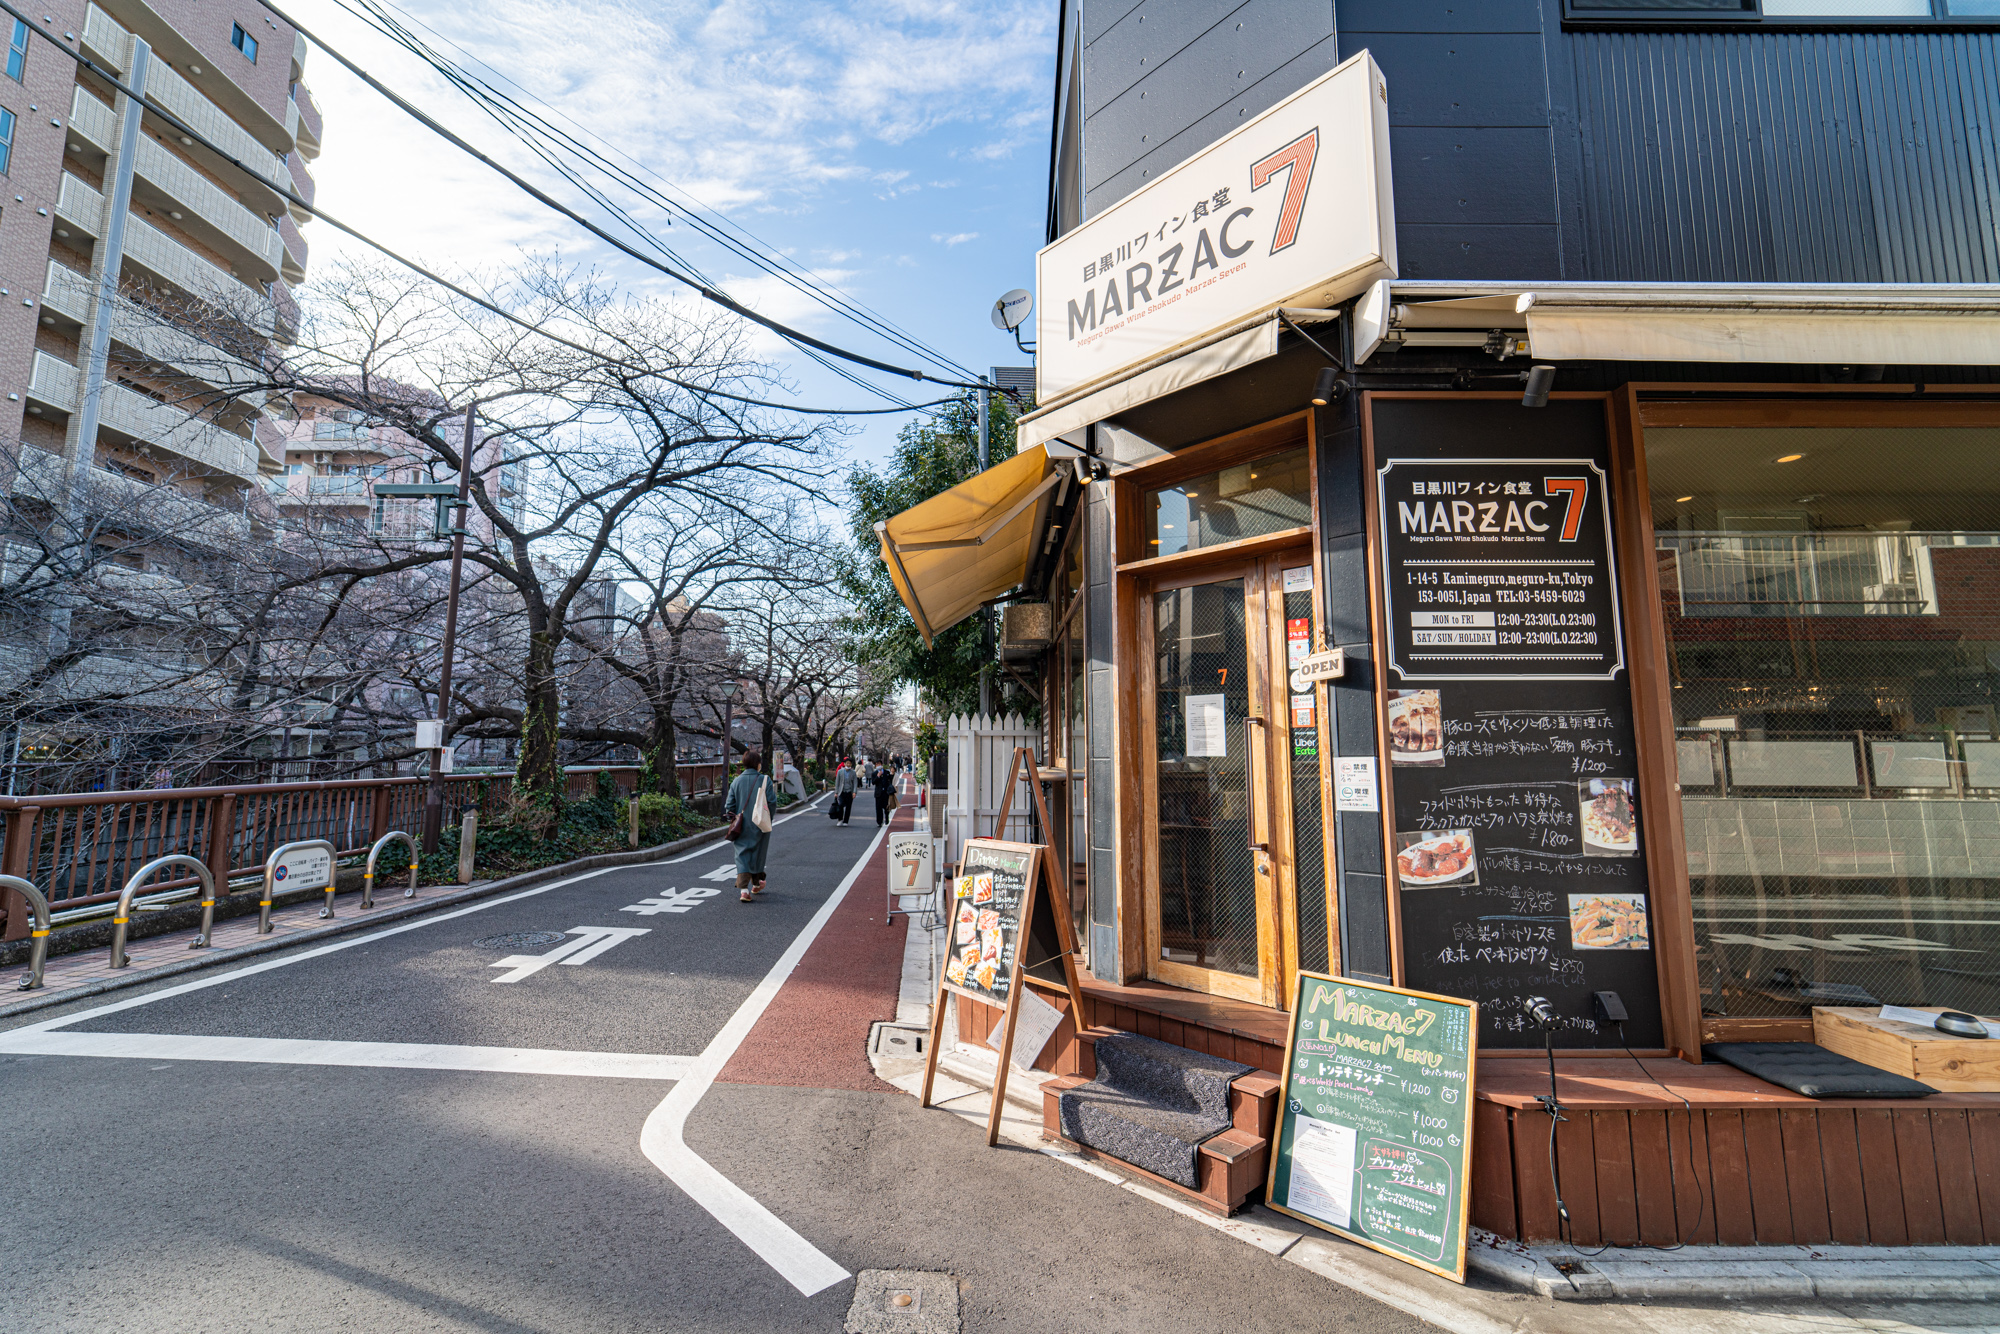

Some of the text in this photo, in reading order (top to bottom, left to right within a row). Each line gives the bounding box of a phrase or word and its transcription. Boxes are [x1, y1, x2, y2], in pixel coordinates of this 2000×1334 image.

[1250, 126, 1320, 257] 7
[1083, 186, 1232, 283] 目黒川ワイン食堂
[1067, 206, 1255, 341] MARZAC
[1077, 262, 1247, 348] Meguro Gawa Wine Shokudo Marzac Seven
[1412, 481, 1533, 495] 目黒川ワイン食堂
[1398, 500, 1550, 534] MARZAC
[1543, 476, 1588, 543] 7
[1410, 535, 1434, 543] Meguro
[1407, 572, 1593, 588] 1-14-5 Kamimeguro,meguro-ku,Tokyo
[1418, 590, 1586, 605] 153-0051,Japan TEL:03-5459-6029
[1432, 615, 1475, 624] MON to FRI
[1416, 633, 1493, 643] SAT/SUN/HOLIDAY
[1301, 658, 1340, 676] OPEN
[1217, 668, 1228, 686] 7
[1294, 738, 1316, 747] Uber
[1295, 746, 1317, 756] Eats
[1353, 763, 1368, 771] 禁煙
[1875, 745, 1895, 776] 7
[894, 847, 929, 860] MARZAC
[1015, 856, 1028, 870] 7
[902, 858, 920, 886] 7
[1318, 1062, 1384, 1086] トンテキランチ
